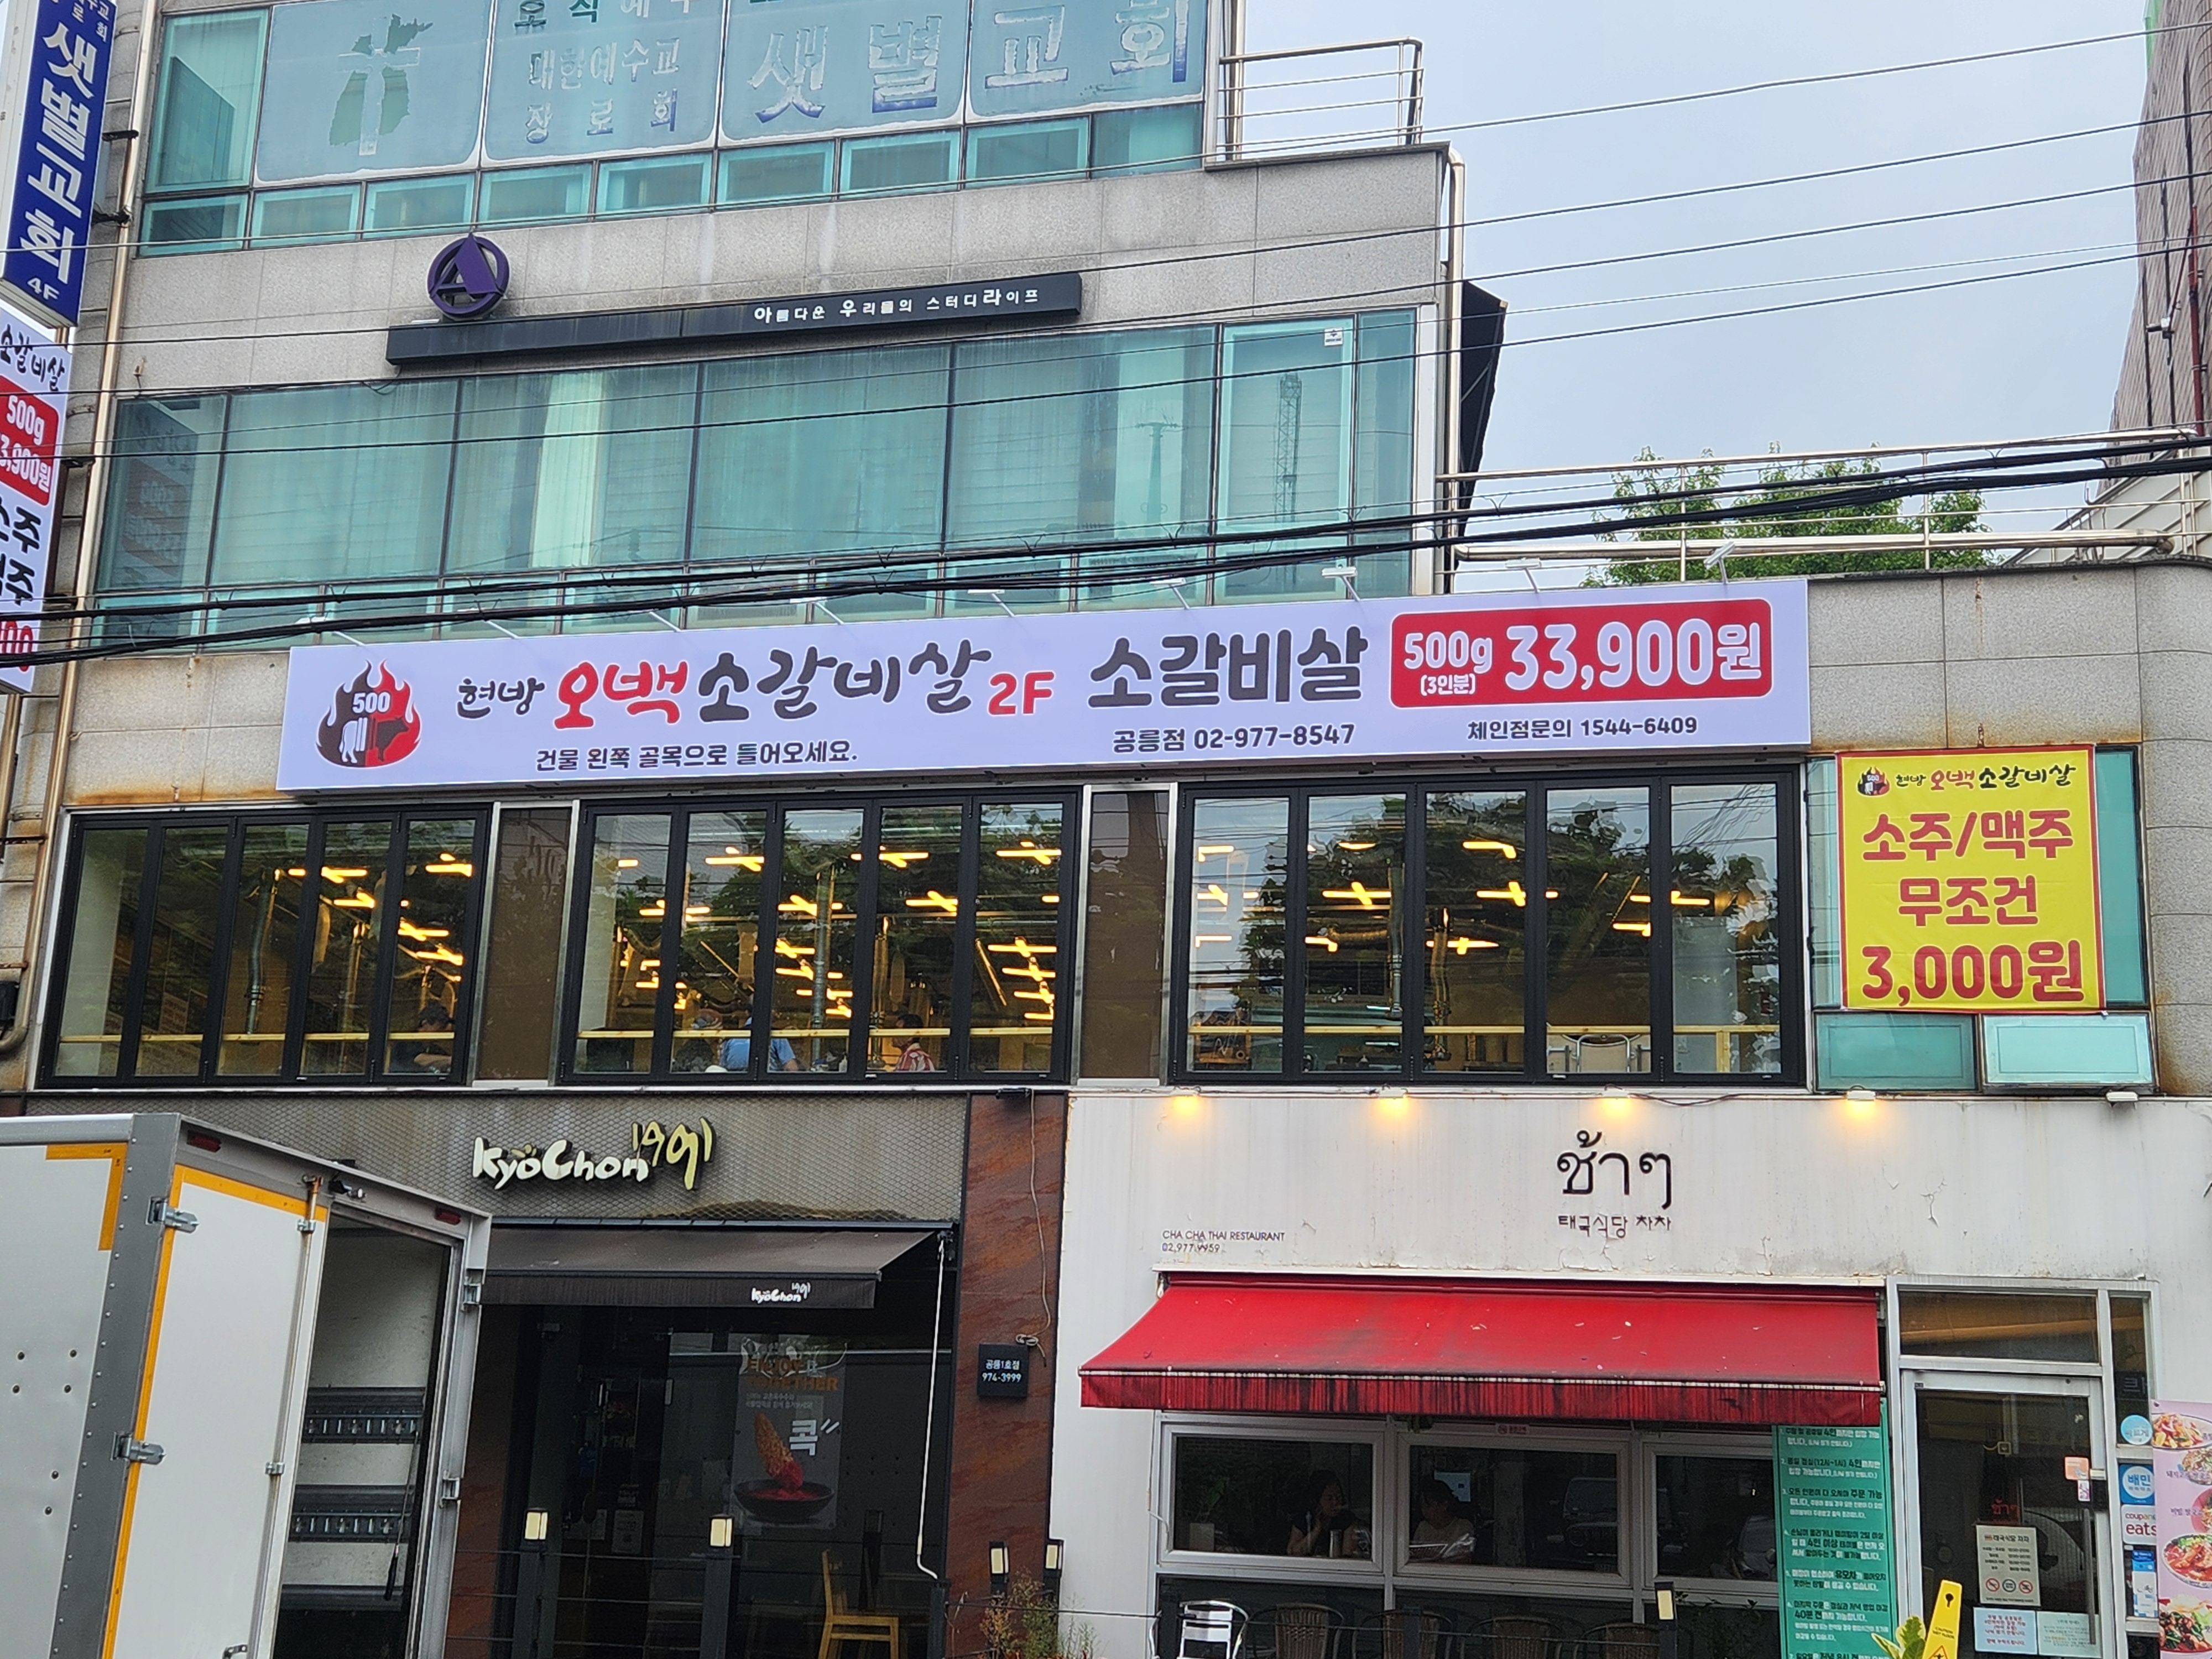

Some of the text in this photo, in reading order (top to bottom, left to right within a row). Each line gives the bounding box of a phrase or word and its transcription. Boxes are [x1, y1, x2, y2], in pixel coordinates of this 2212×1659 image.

[529, 37, 680, 90] 대한예수교
[747, 0, 1187, 123] 샛별교회
[20, 22, 97, 285] 샛별교회
[27, 277, 60, 300] 4F
[7, 395, 45, 446] 500g
[1087, 625, 1369, 708] 소갈비살
[1404, 617, 1762, 692] 500g 33,900원
[352, 692, 390, 714] 500
[988, 671, 1055, 715] 2F
[1420, 674, 1477, 697] (3인분)
[1113, 723, 1355, 754] 공릉점 02-977-8547
[1467, 716, 1698, 740] 체인점문의 1544-6409
[536, 740, 858, 771] 건물 왼쪽 골목으로 들어오세요.
[1862, 808, 2074, 862] 소주/맥주
[1898, 874, 2039, 927] 무조건
[1861, 939, 2085, 1007] 3,000원
[632, 1117, 714, 1191] 1991
[1162, 1230, 1285, 1241] CHA CHA THAI RESTAURANT
[1557, 1213, 1672, 1239] 태국식당 차차
[982, 1373, 1022, 1383] 974-3999
[789, 1419, 818, 1457] 콕
[2127, 1474, 2151, 1486] 배민
[2126, 1522, 2157, 1536] eats
